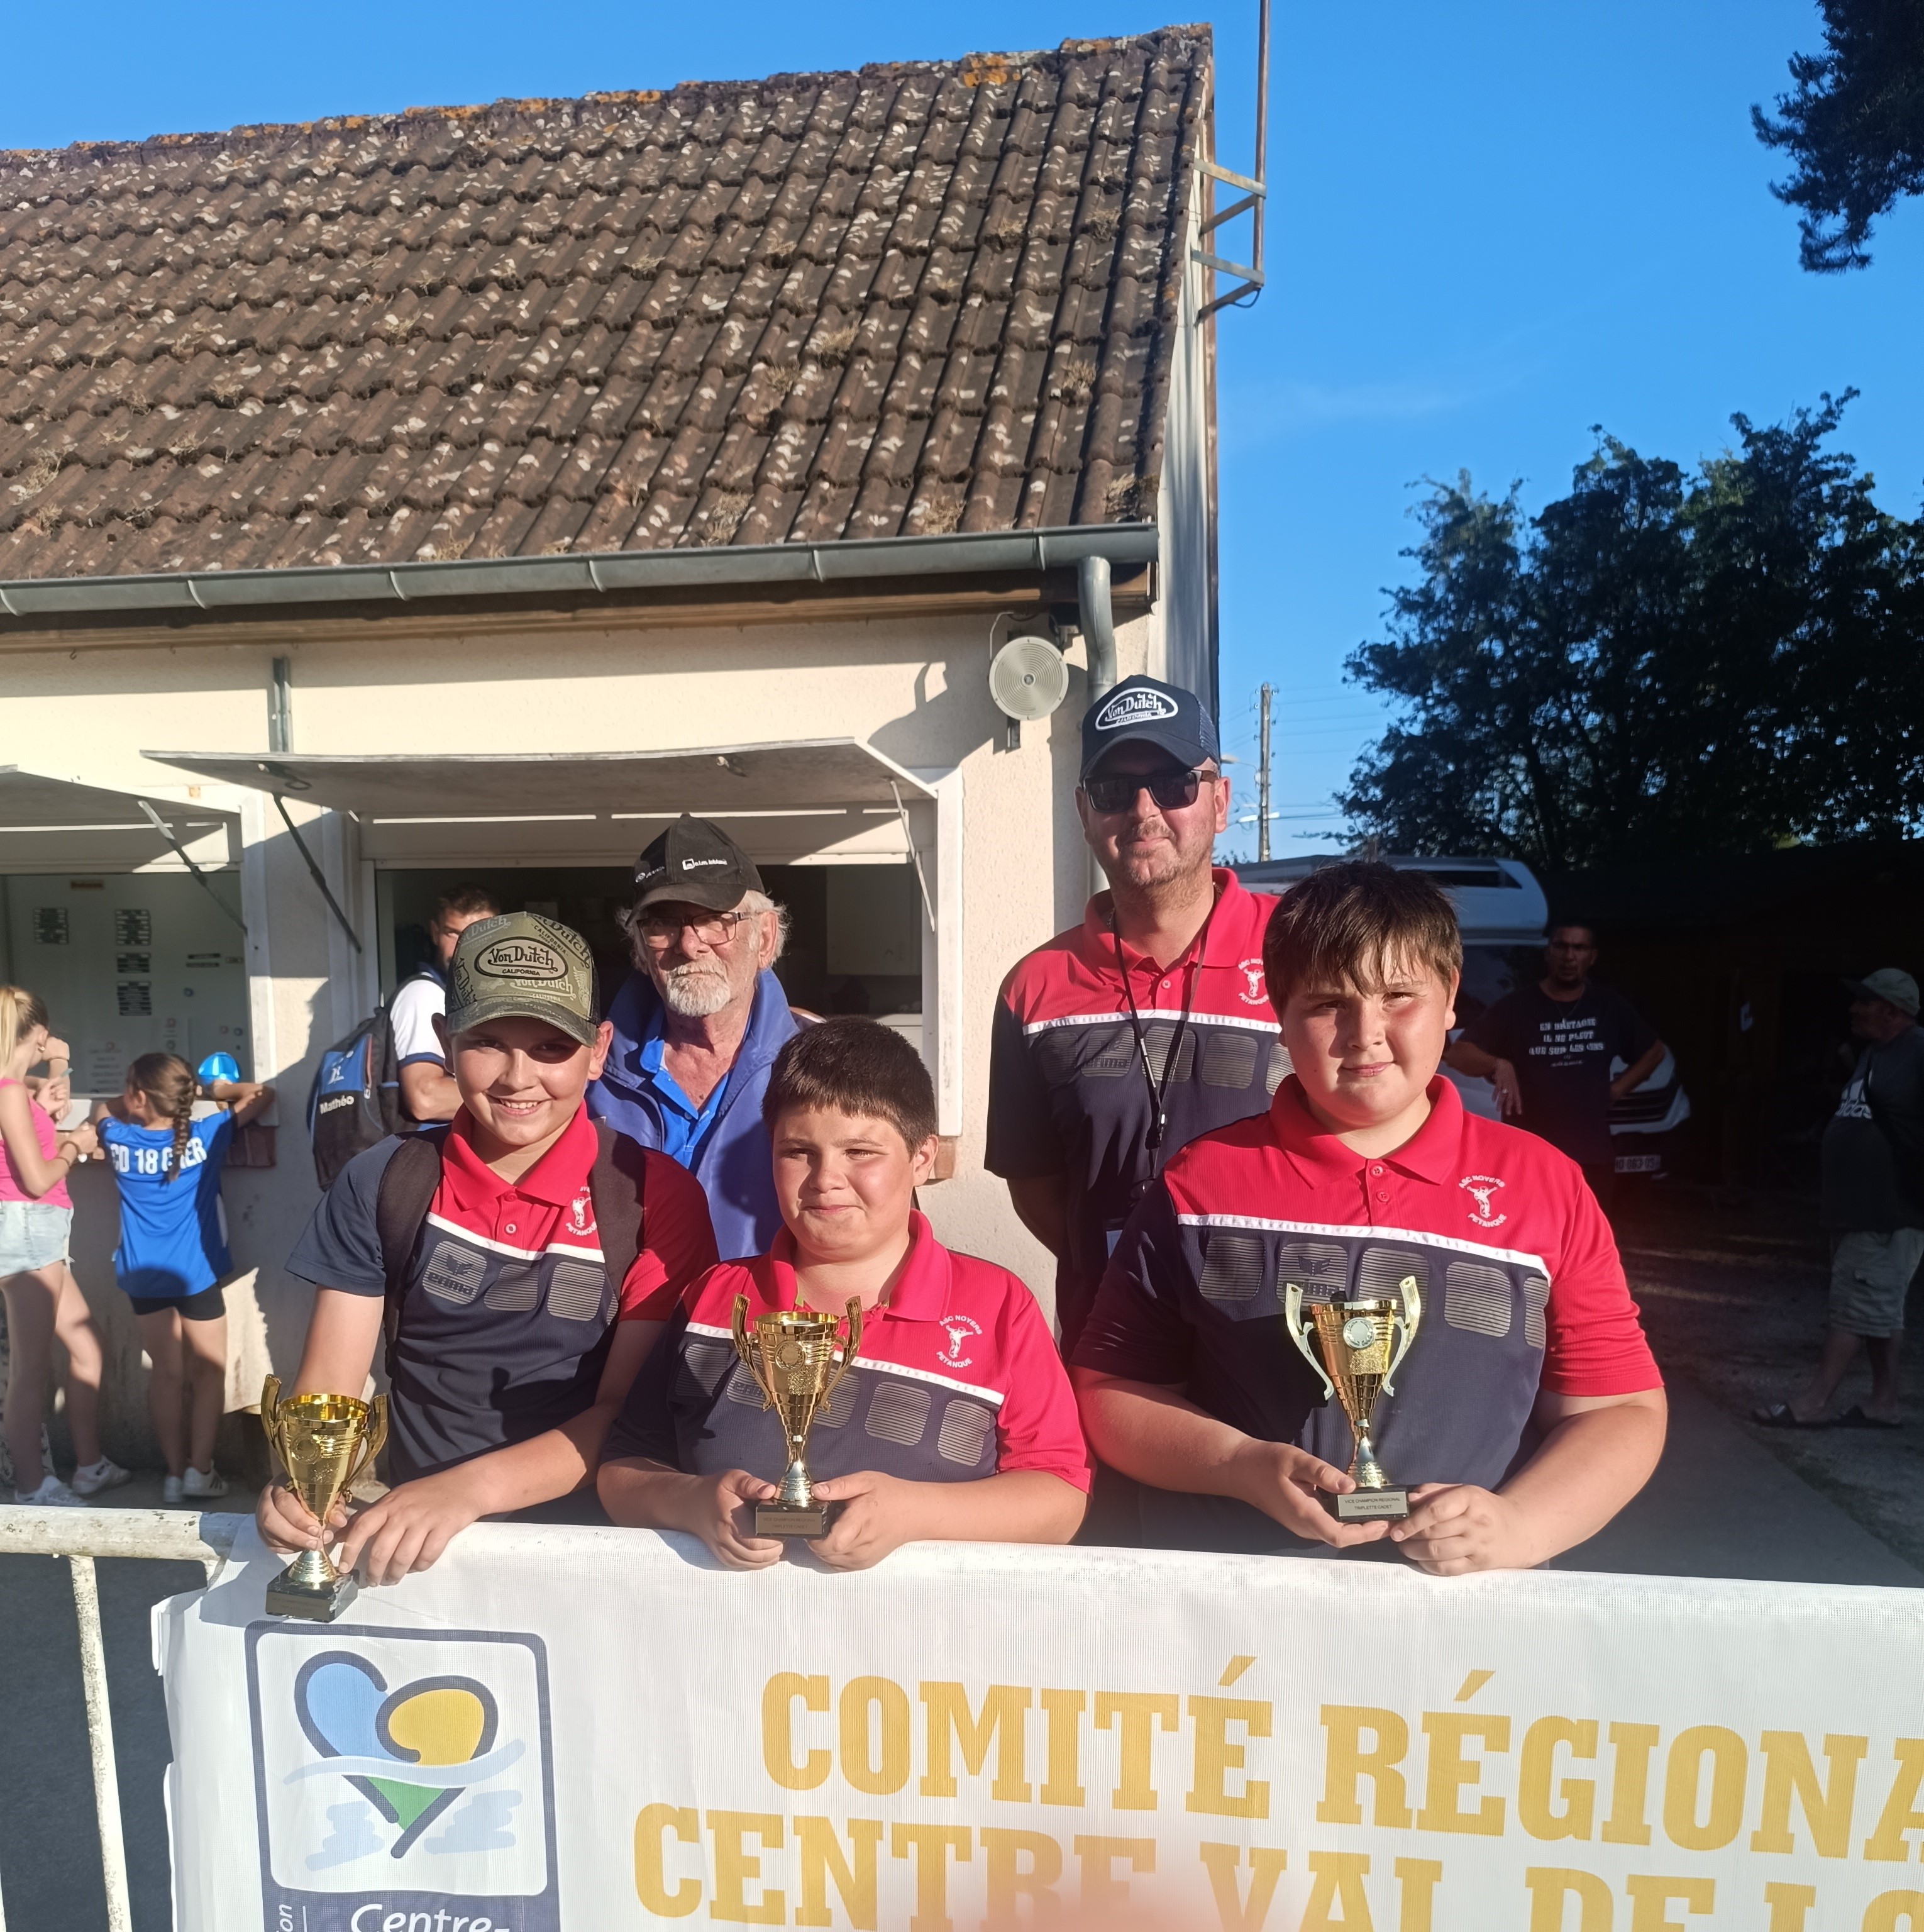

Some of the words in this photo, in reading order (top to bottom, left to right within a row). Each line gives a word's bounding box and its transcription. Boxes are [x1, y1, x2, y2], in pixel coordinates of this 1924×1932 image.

[1107, 704, 1125, 719] Von
[1124, 693, 1166, 715] Dutch
[488, 947, 514, 963] Von
[513, 945, 556, 970] Dutch
[502, 969, 541, 977] CALIFORNIA
[1554, 1033, 1566, 1043] NE
[319, 1095, 355, 1114] Mathéo
[135, 1148, 158, 1174] 18
[955, 1315, 982, 1335] NOYERS
[936, 1351, 973, 1368] PETANQUE
[761, 1655, 1273, 1819] COMITÉ
[1315, 1669, 1924, 1862] RÉGIONA
[634, 1802, 1157, 1932] CENTRE
